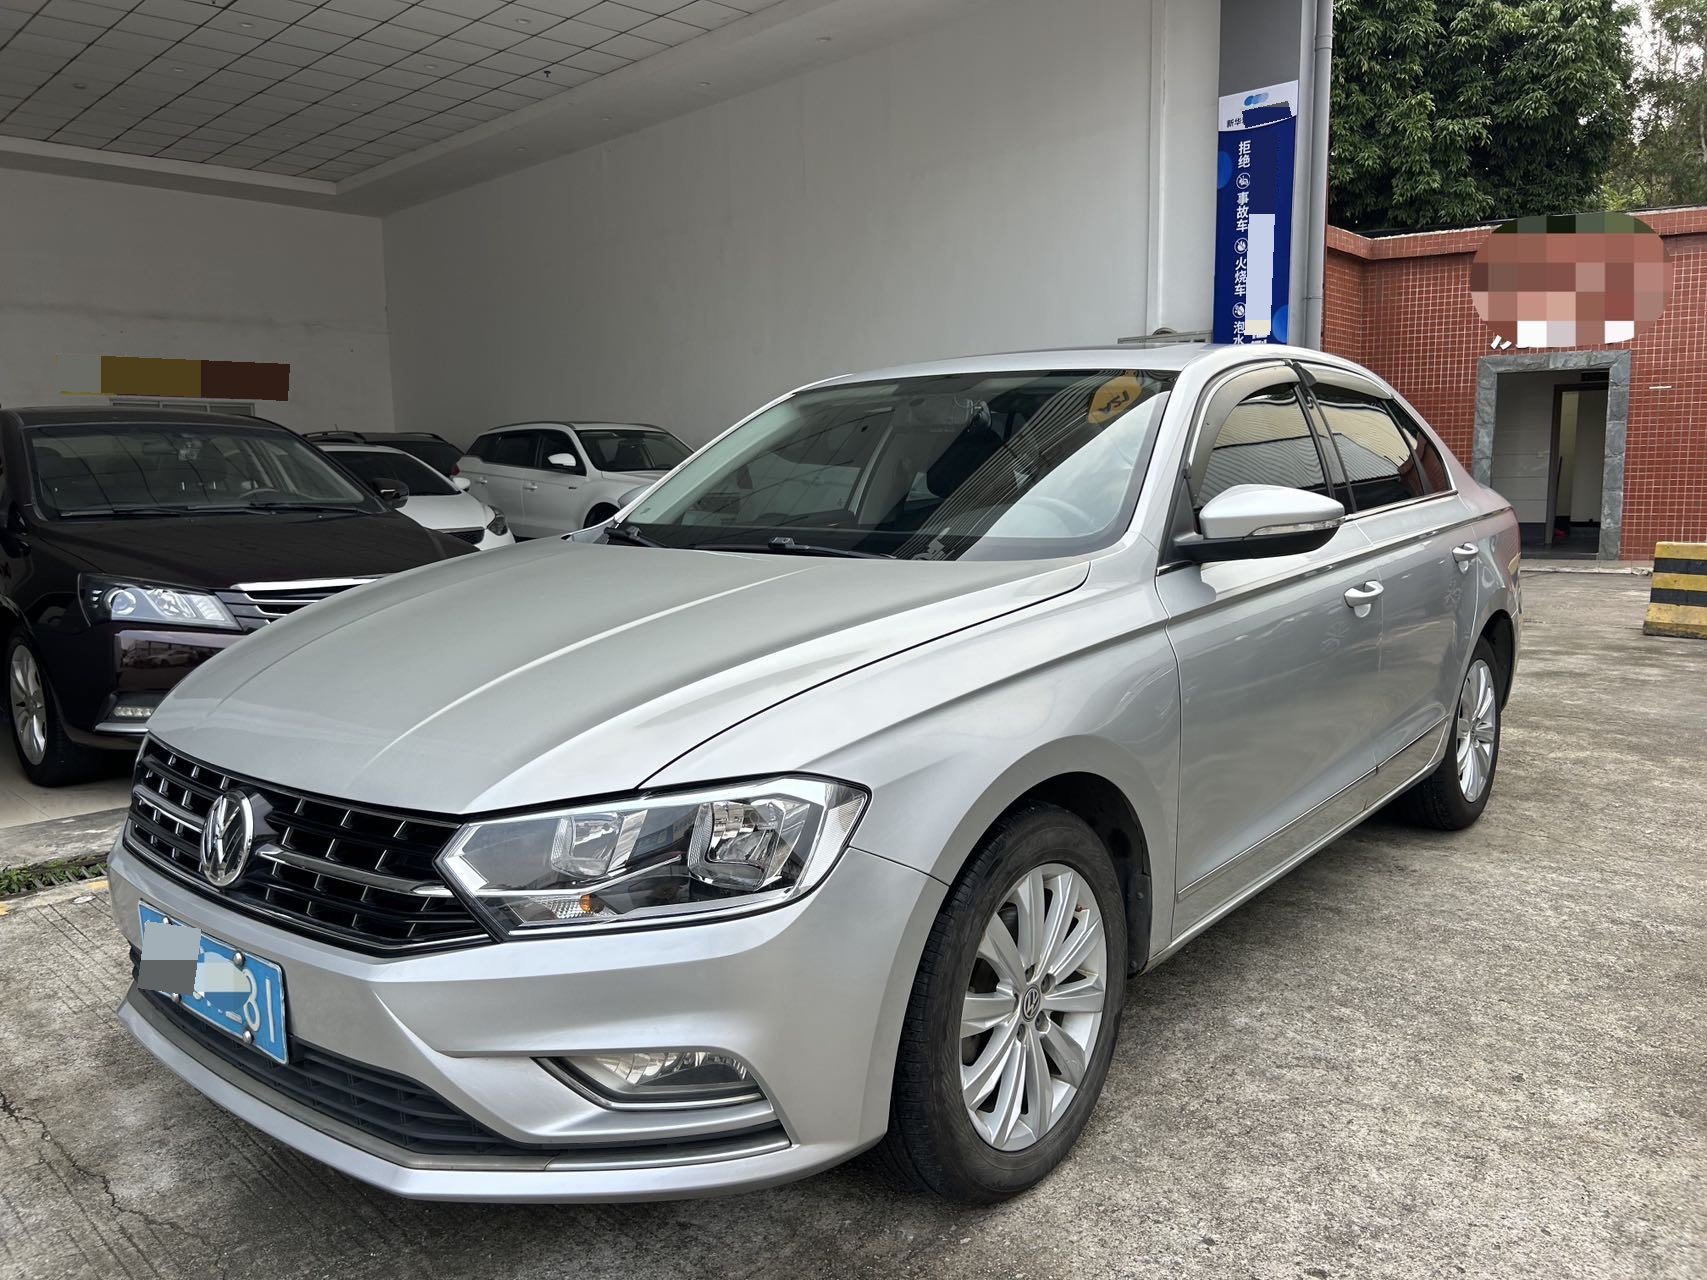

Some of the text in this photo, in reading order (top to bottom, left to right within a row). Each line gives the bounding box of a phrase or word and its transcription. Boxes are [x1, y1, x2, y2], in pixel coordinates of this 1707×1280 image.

[1237, 140, 1251, 169] 拒绝
[1235, 191, 1250, 232] 事故车
[1234, 256, 1247, 297] 火烧车
